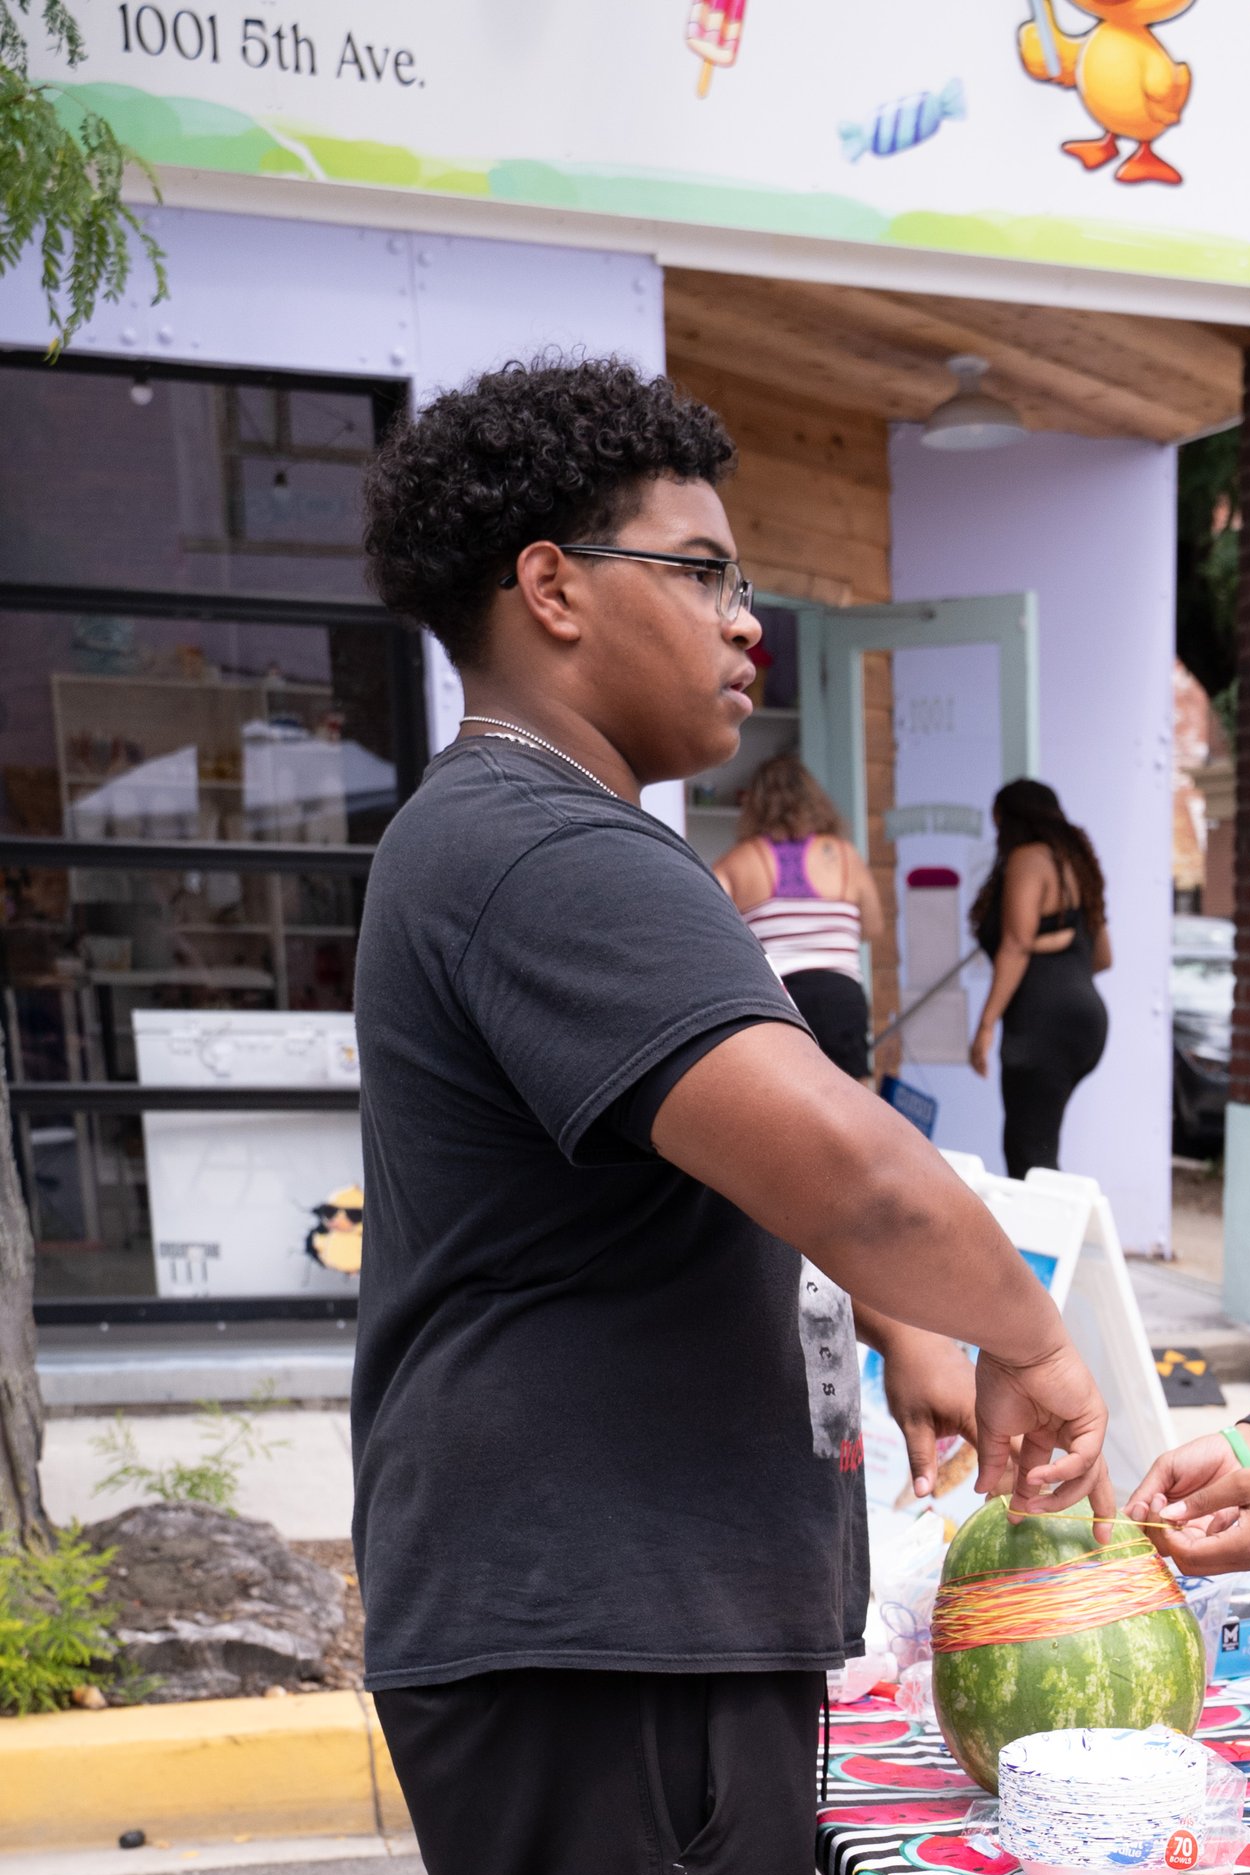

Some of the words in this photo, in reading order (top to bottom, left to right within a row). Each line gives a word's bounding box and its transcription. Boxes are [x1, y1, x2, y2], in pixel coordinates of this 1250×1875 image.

[118, 3, 220, 63] 1001
[240, 18, 318, 76] 5th
[335, 30, 426, 88] Ave.
[1173, 1836, 1193, 1856] 70
[1169, 1856, 1192, 1865] BOWLS
